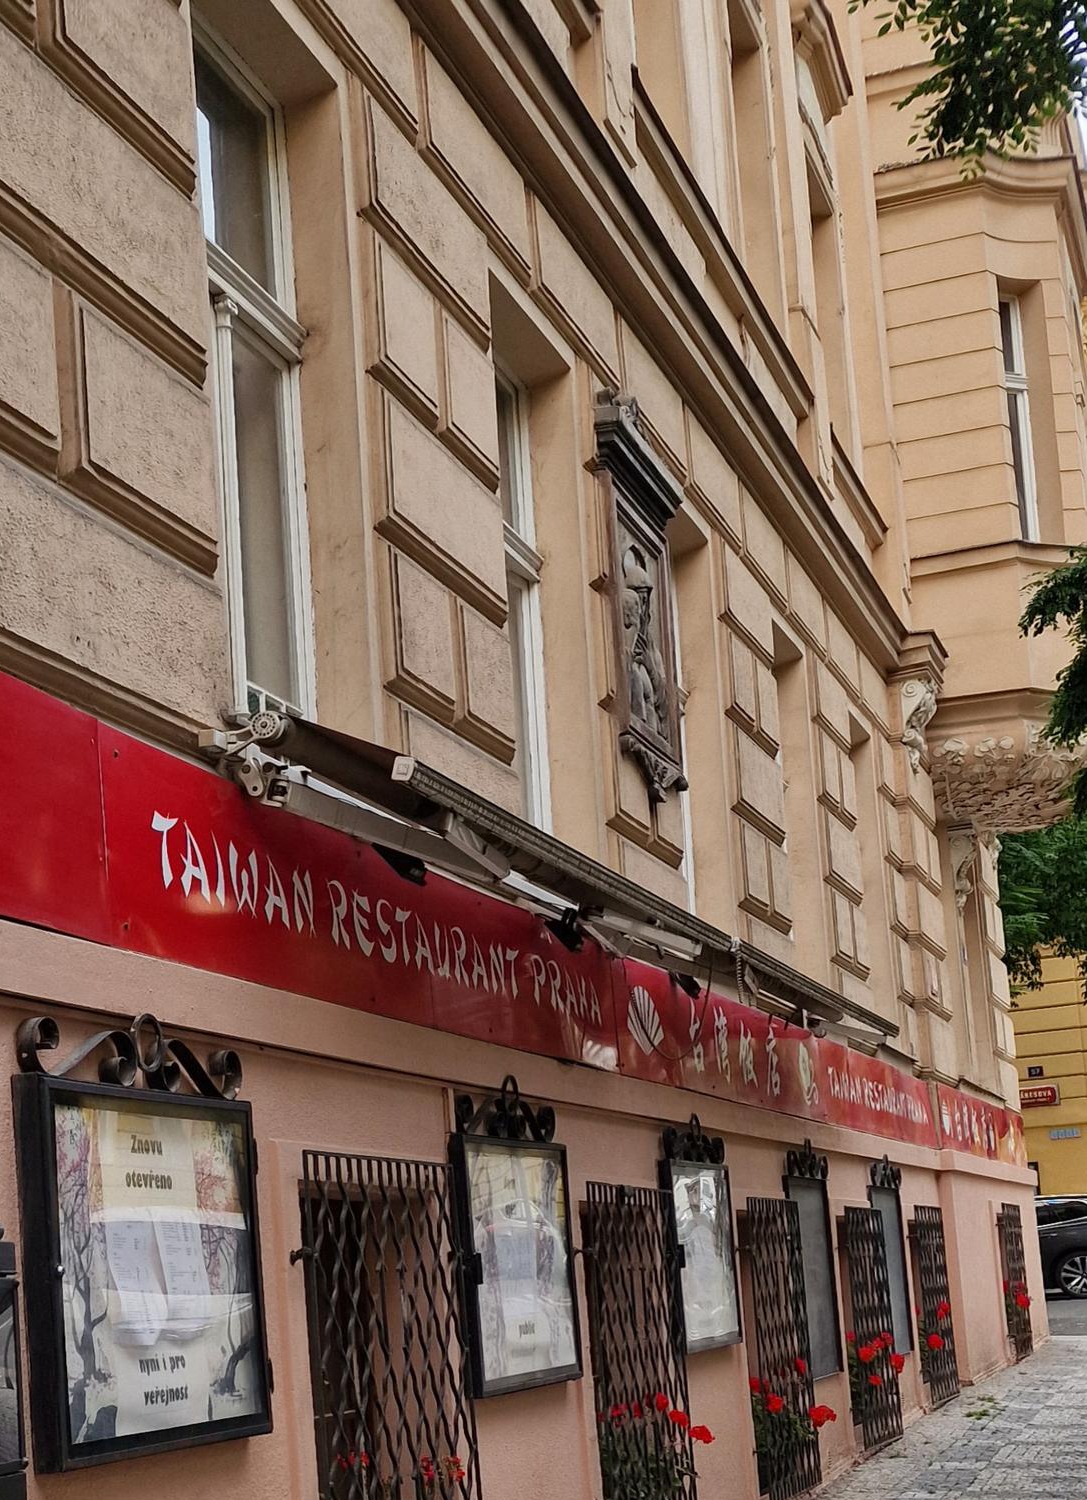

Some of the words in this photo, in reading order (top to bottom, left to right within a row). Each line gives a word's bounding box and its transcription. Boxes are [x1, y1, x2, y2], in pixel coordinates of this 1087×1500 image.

[151, 811, 314, 937] TAIWAN
[326, 879, 519, 999] RESTAURANT
[530, 953, 603, 1026] PRAHA
[130, 1134, 163, 1154] Znovu
[126, 1169, 173, 1190] otevřeno
[162, 1353, 167, 1371] i
[169, 1355, 186, 1374] pro
